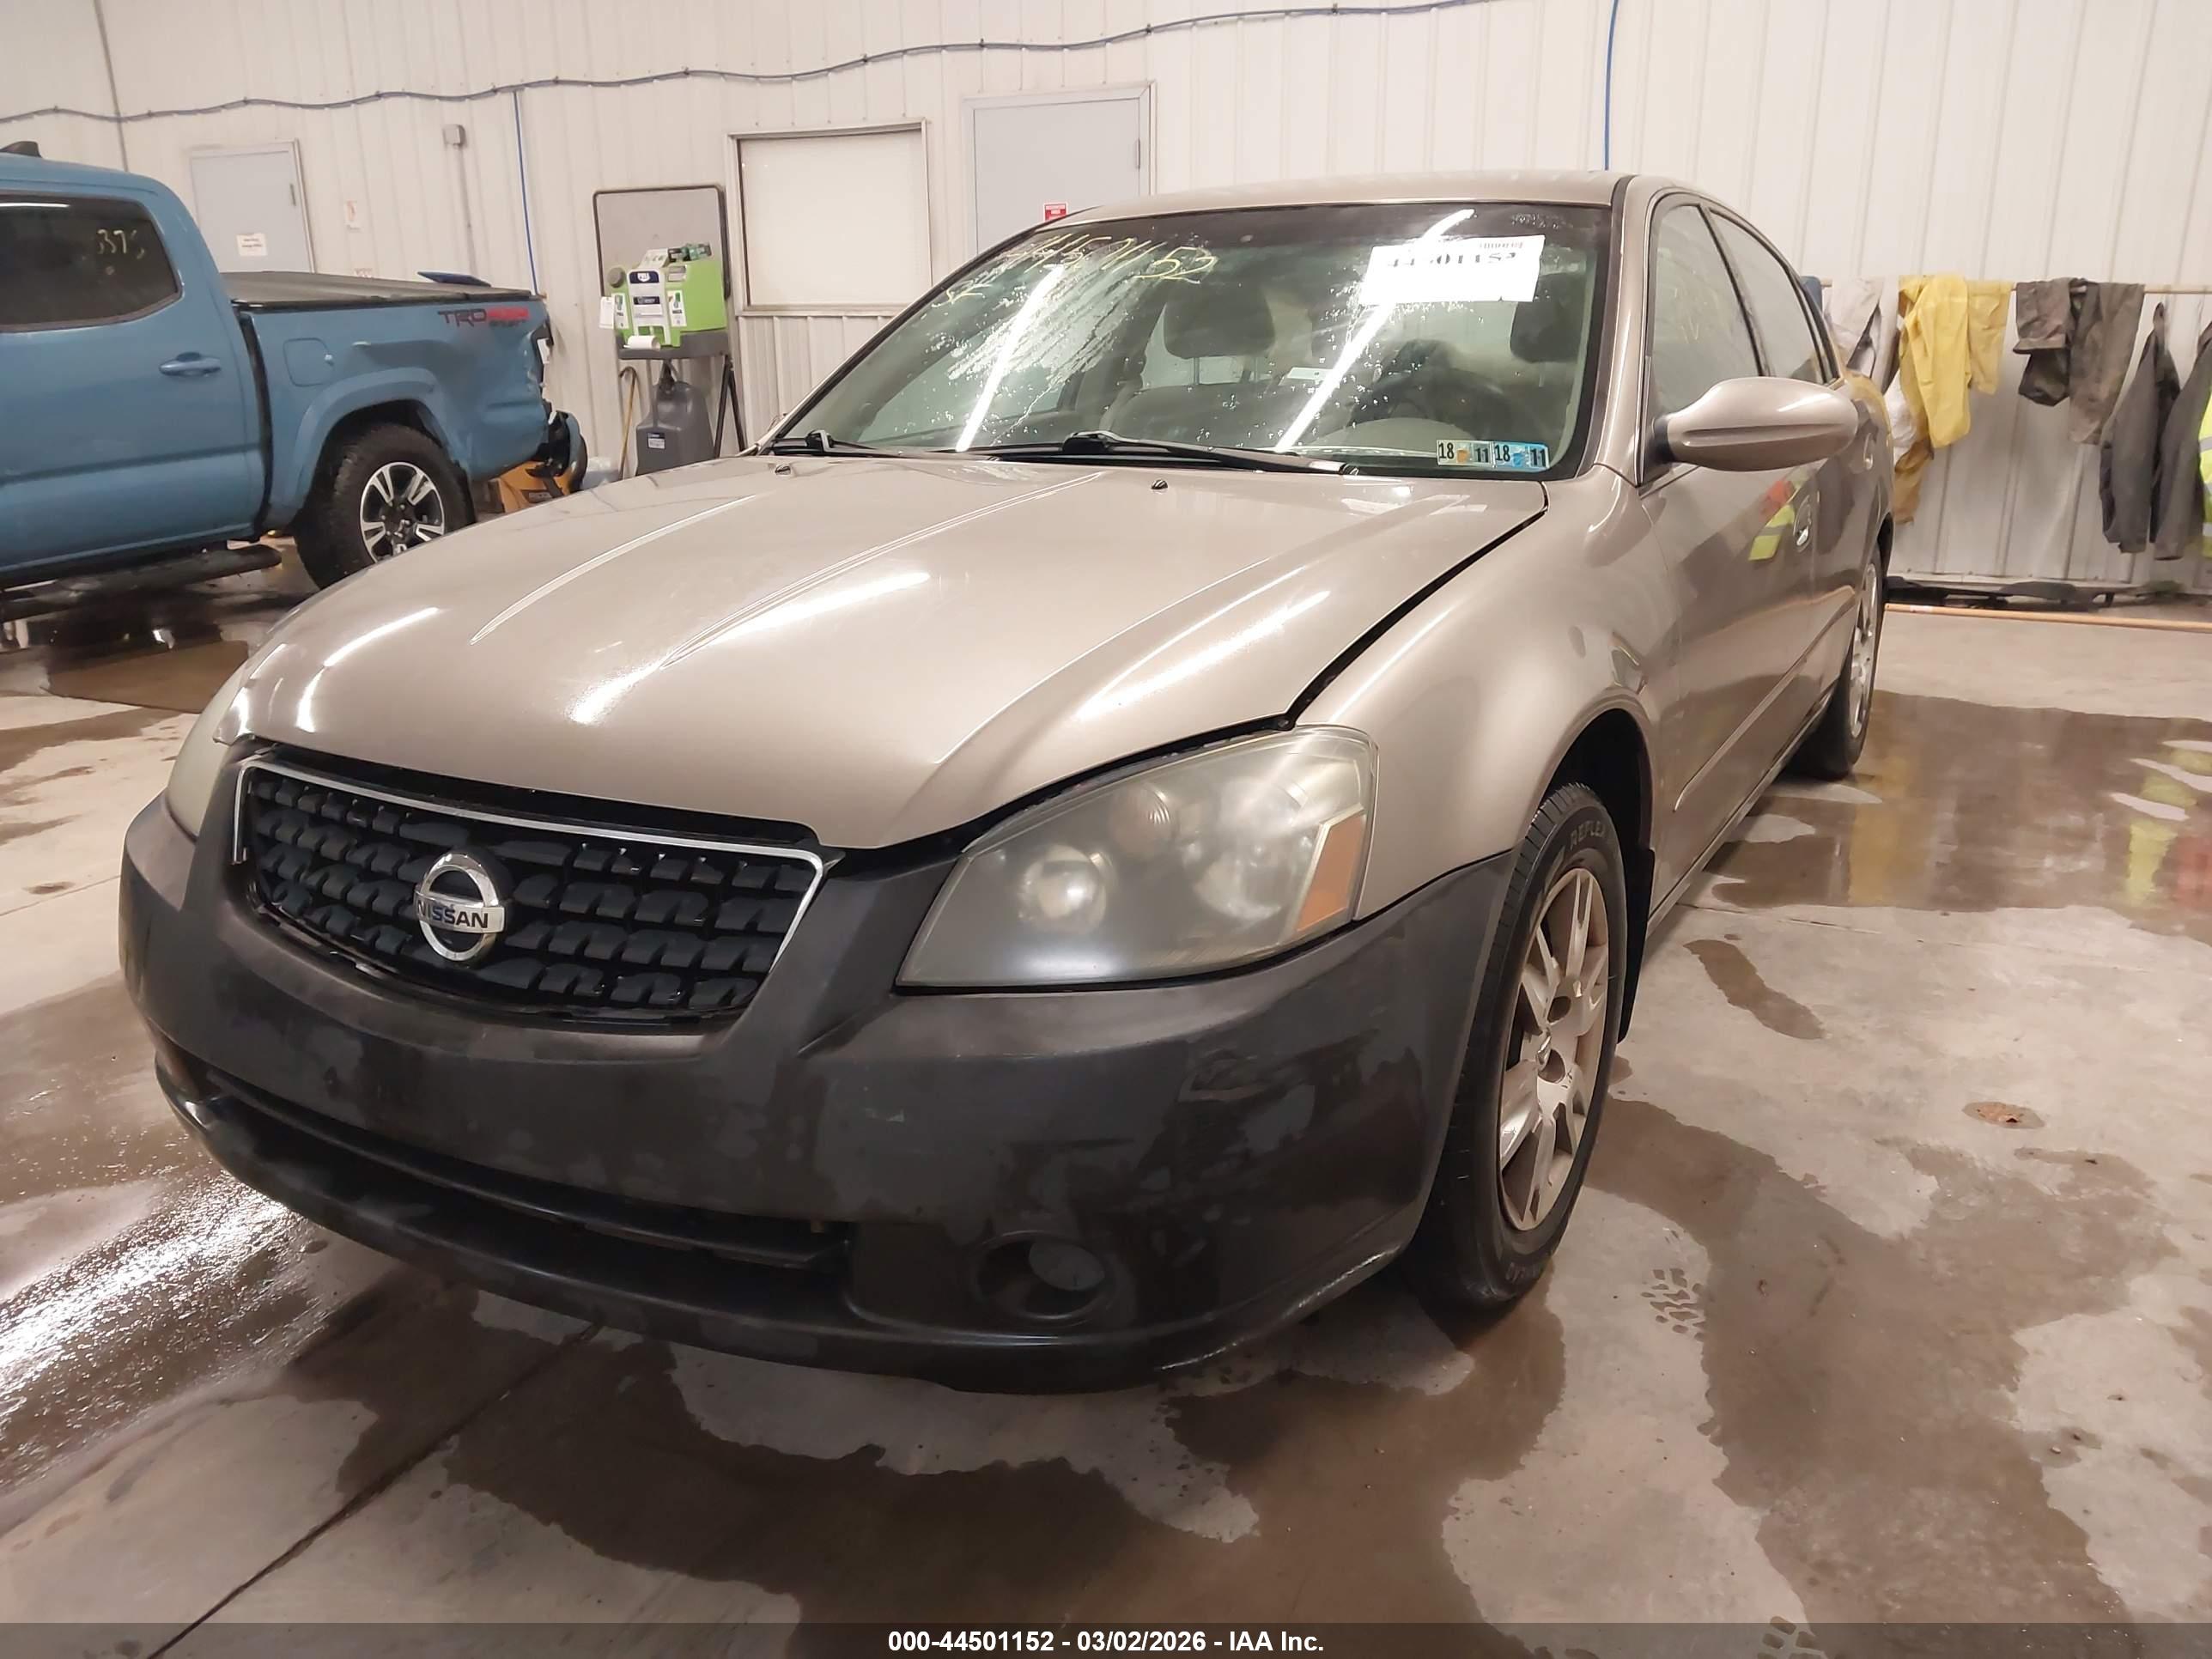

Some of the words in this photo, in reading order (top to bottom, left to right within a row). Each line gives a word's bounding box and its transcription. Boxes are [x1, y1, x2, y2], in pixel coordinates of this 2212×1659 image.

[1438, 442, 1455, 459] 18
[1474, 447, 1489, 463] 11
[1494, 444, 1511, 462] 18
[1530, 447, 1547, 467] 11
[416, 899, 489, 929] NISSAN
